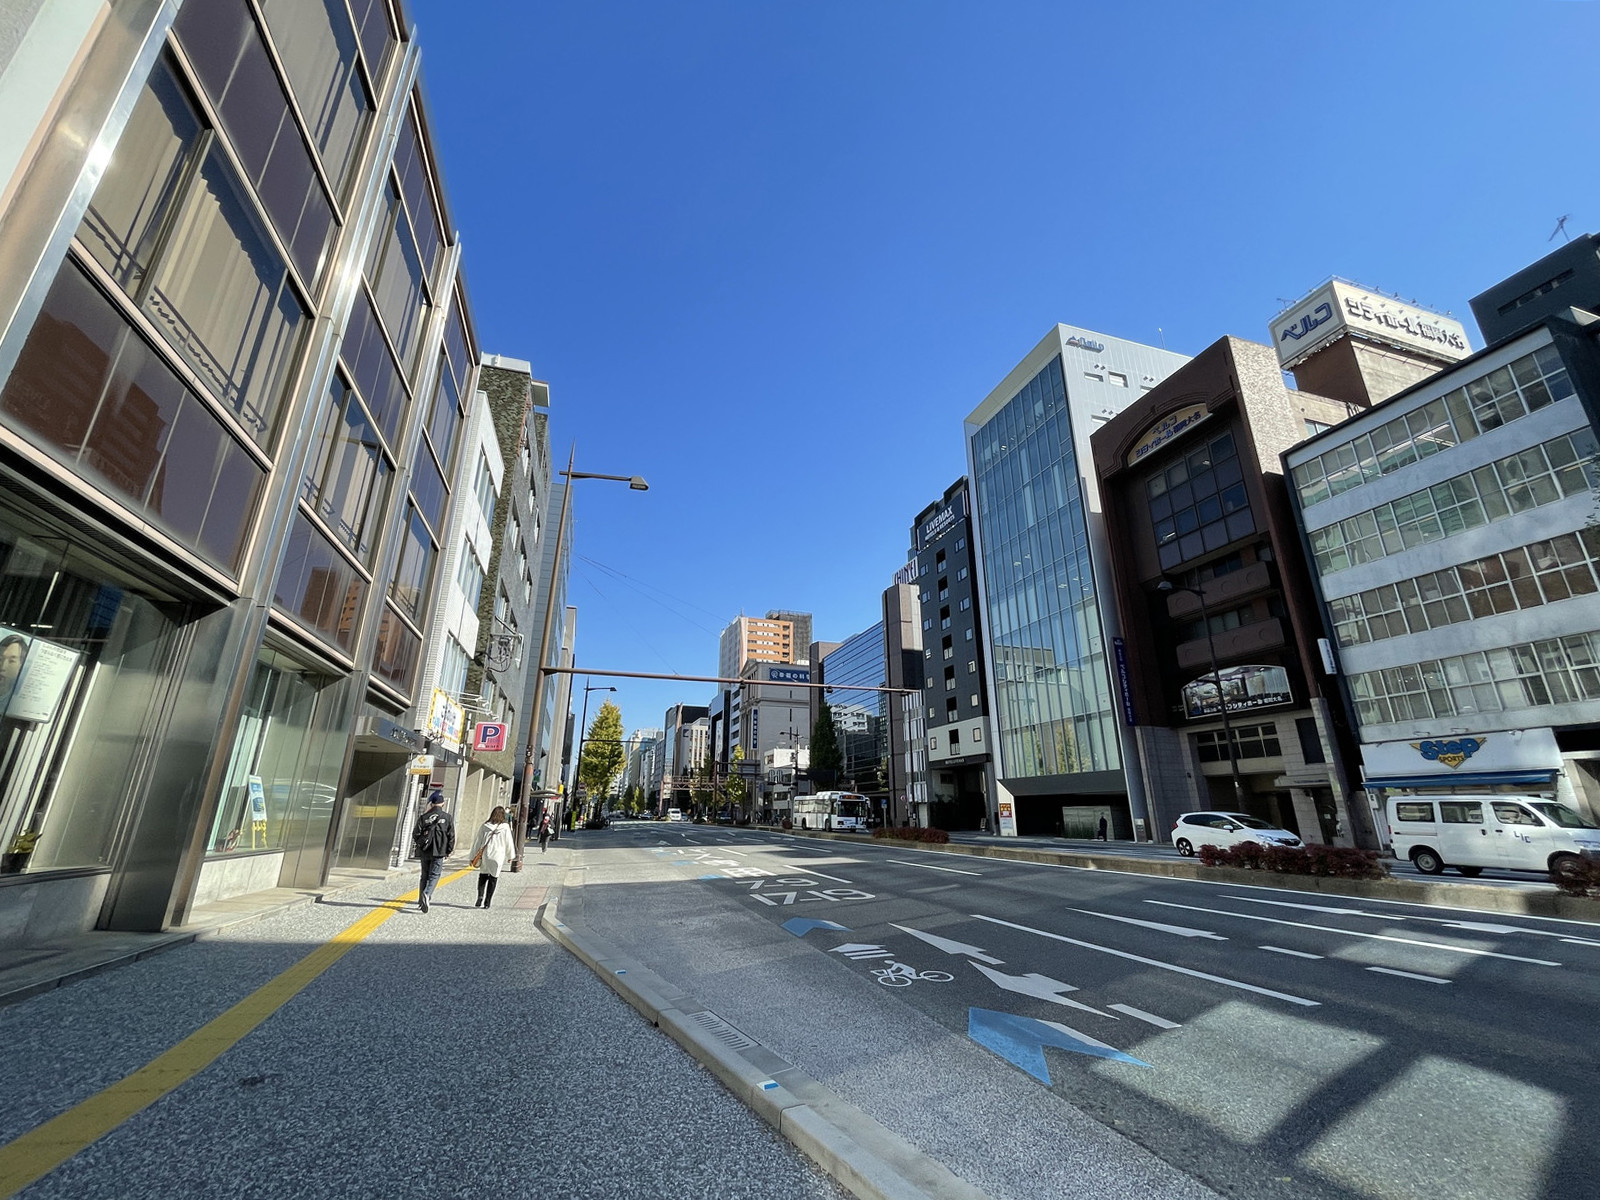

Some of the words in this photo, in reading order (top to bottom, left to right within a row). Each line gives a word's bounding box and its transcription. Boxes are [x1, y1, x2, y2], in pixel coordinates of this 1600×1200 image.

[1280, 302, 1333, 342] ベルコ
[926, 505, 953, 534] LIVEMAX
[481, 725, 500, 743] P
[735, 877, 819, 890] 7-9
[750, 888, 876, 906] 17-19
